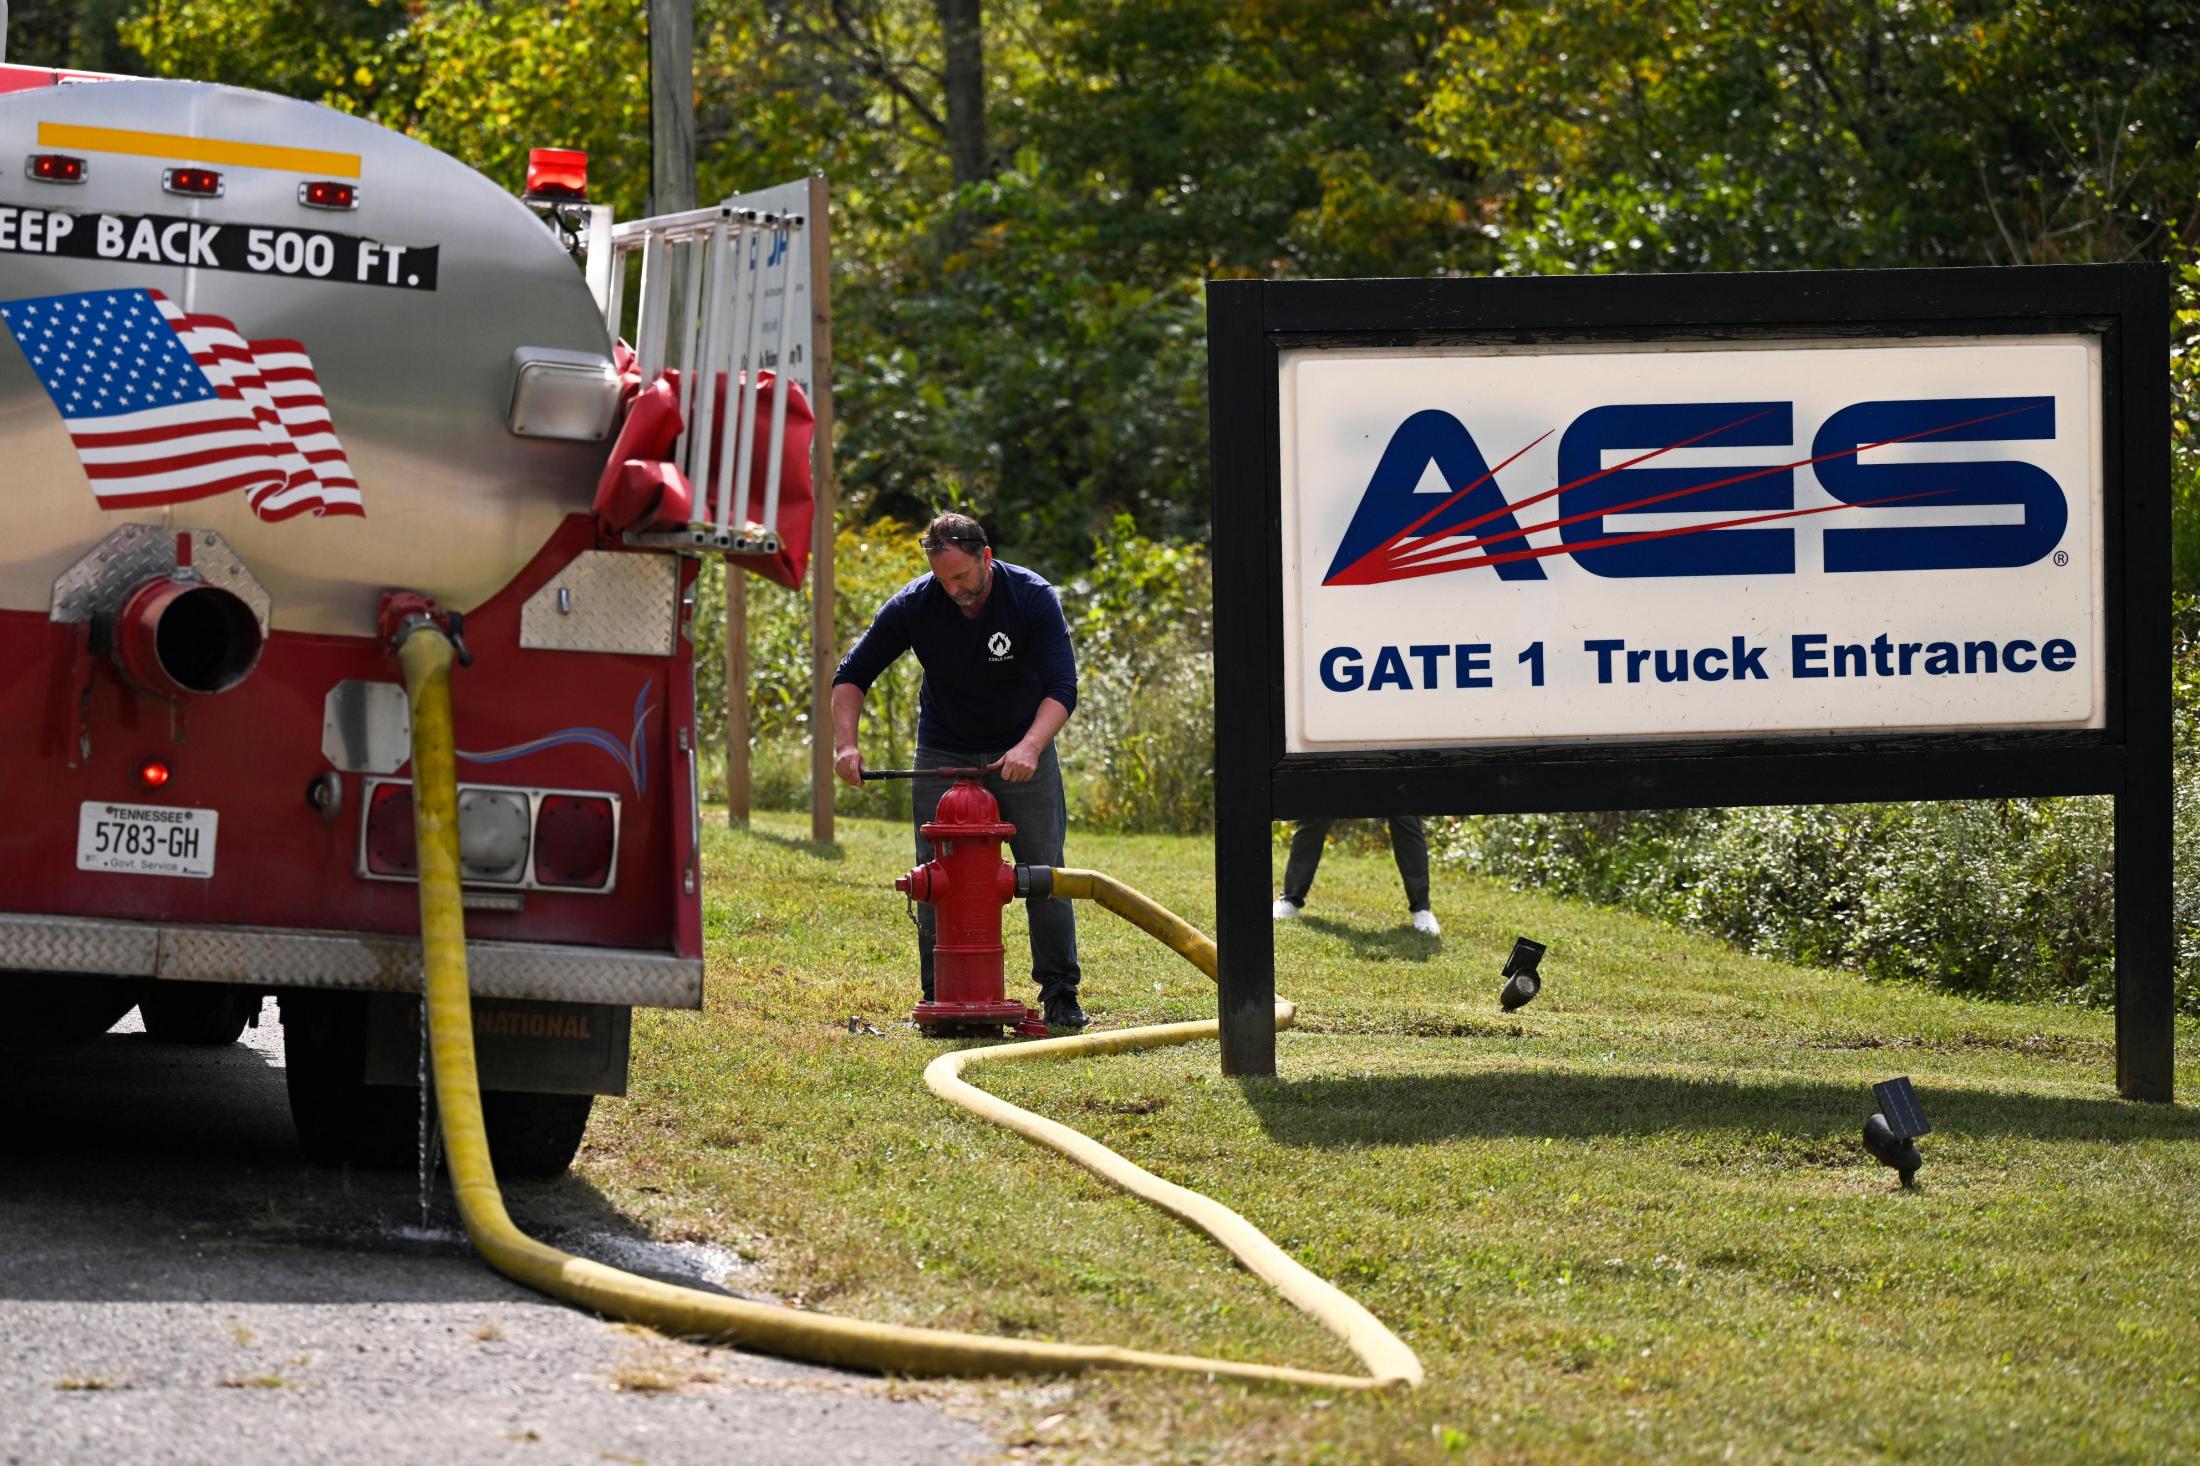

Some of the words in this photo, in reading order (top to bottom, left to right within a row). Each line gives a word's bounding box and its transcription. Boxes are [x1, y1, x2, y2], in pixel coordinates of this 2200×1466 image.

[97, 214, 221, 266] BACK
[246, 229, 335, 277] 500
[357, 240, 419, 286] FT.
[1322, 396, 2069, 586] AES
[1319, 643, 1493, 693] GATE
[1518, 641, 1545, 687] 1
[1584, 635, 1769, 684] Truck
[1791, 632, 2077, 679] Entrance
[112, 807, 184, 823] TENNESSEE
[95, 821, 199, 859] 5783-GH
[140, 859, 178, 872] Service
